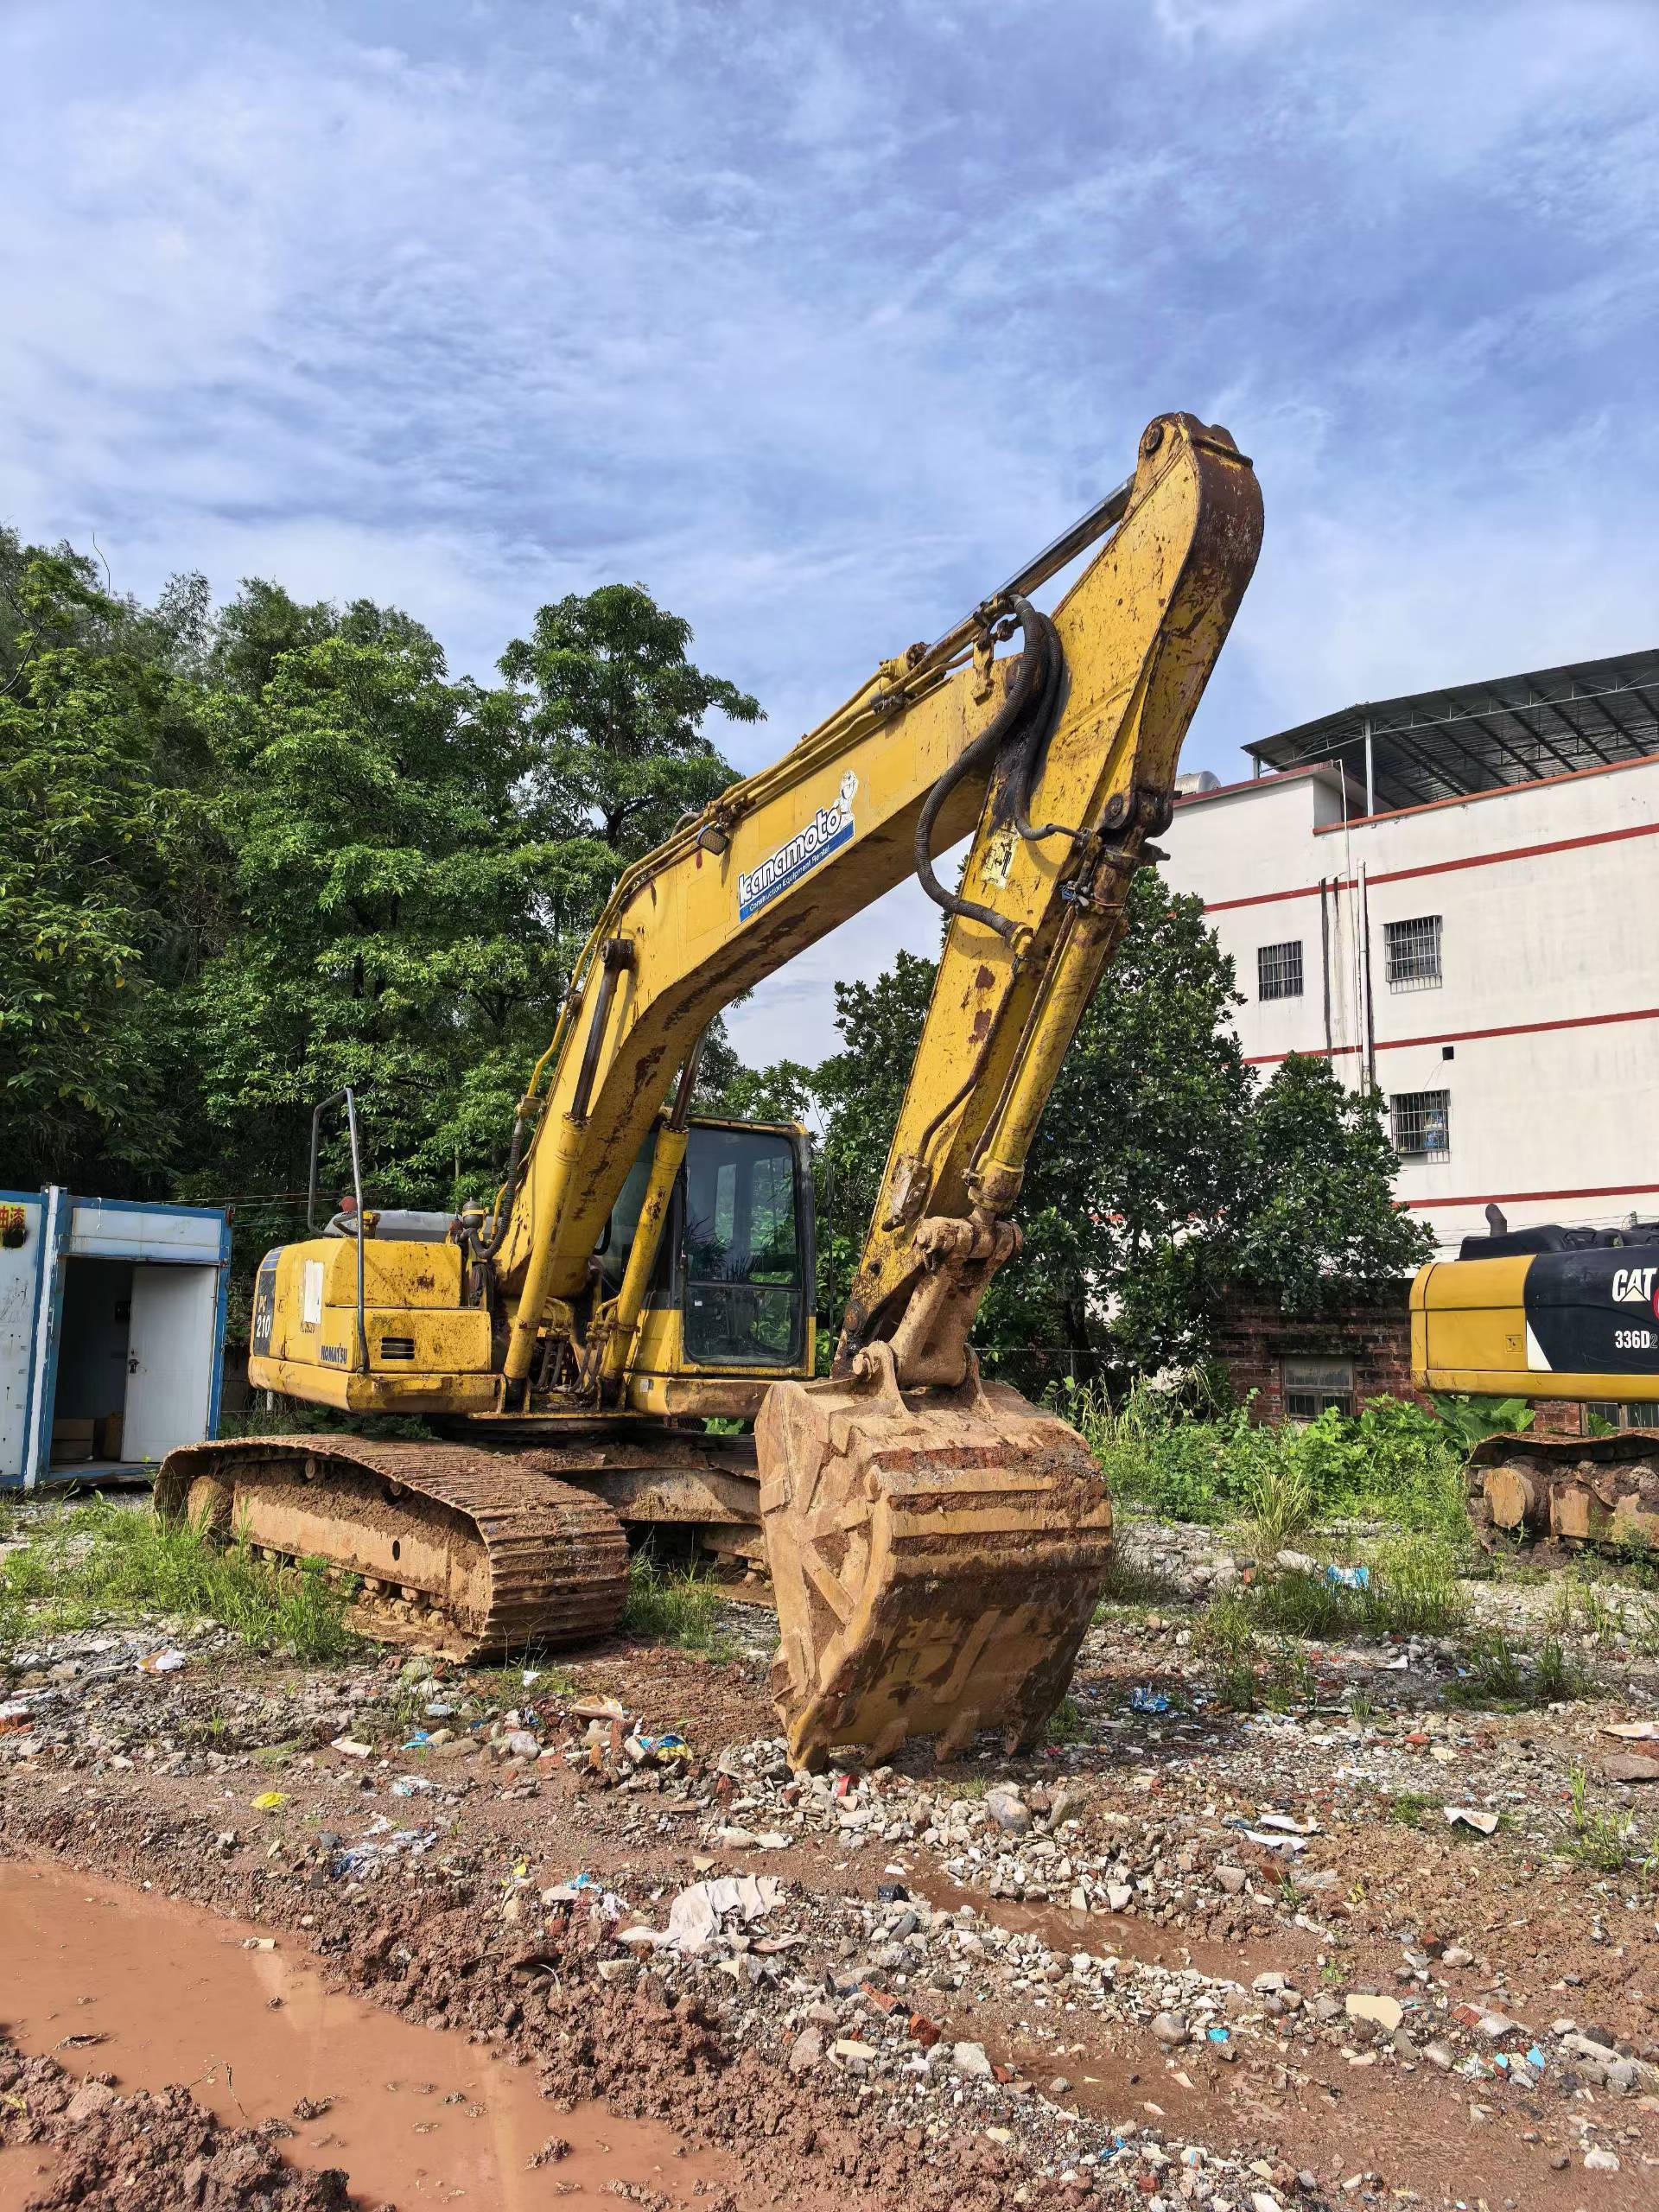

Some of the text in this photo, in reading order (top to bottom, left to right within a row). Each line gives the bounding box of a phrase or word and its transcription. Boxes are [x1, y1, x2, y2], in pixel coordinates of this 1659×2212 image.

[739, 808, 842, 906] kanamoto
[749, 845, 830, 912] Construction Equipment Rental
[1612, 1268, 1657, 1303] CAT
[256, 1314, 270, 1338] 210
[321, 1344, 347, 1364] KOMATSU
